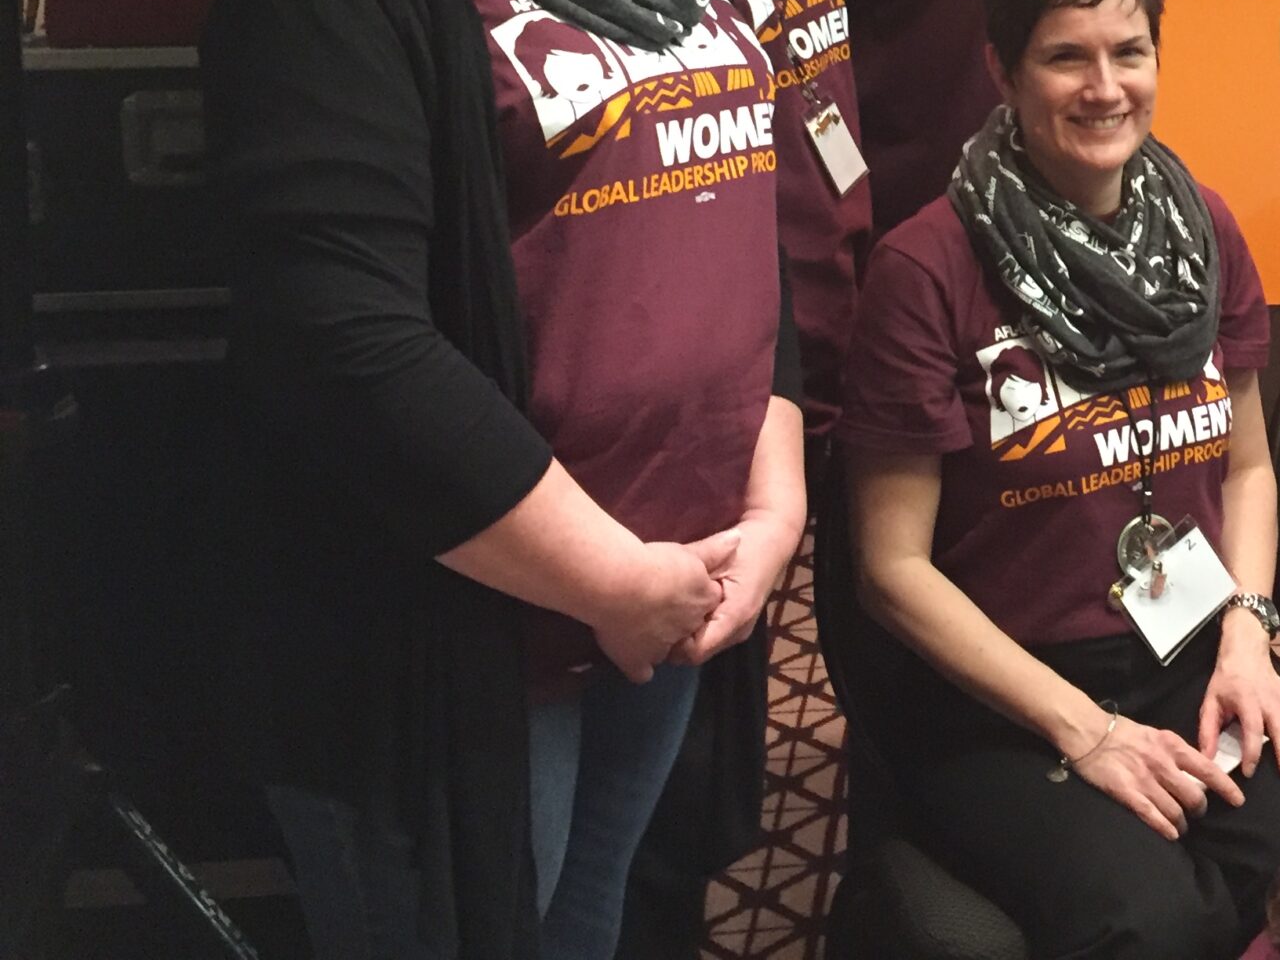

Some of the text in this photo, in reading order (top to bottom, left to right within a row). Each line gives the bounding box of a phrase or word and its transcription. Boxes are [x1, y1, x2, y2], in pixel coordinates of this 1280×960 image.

[553, 179, 640, 218] GLOBAL
[642, 154, 749, 200] LEADERSHIP
[999, 478, 1079, 509] GLOBAL
[1080, 451, 1181, 495] LEADERSHIP
